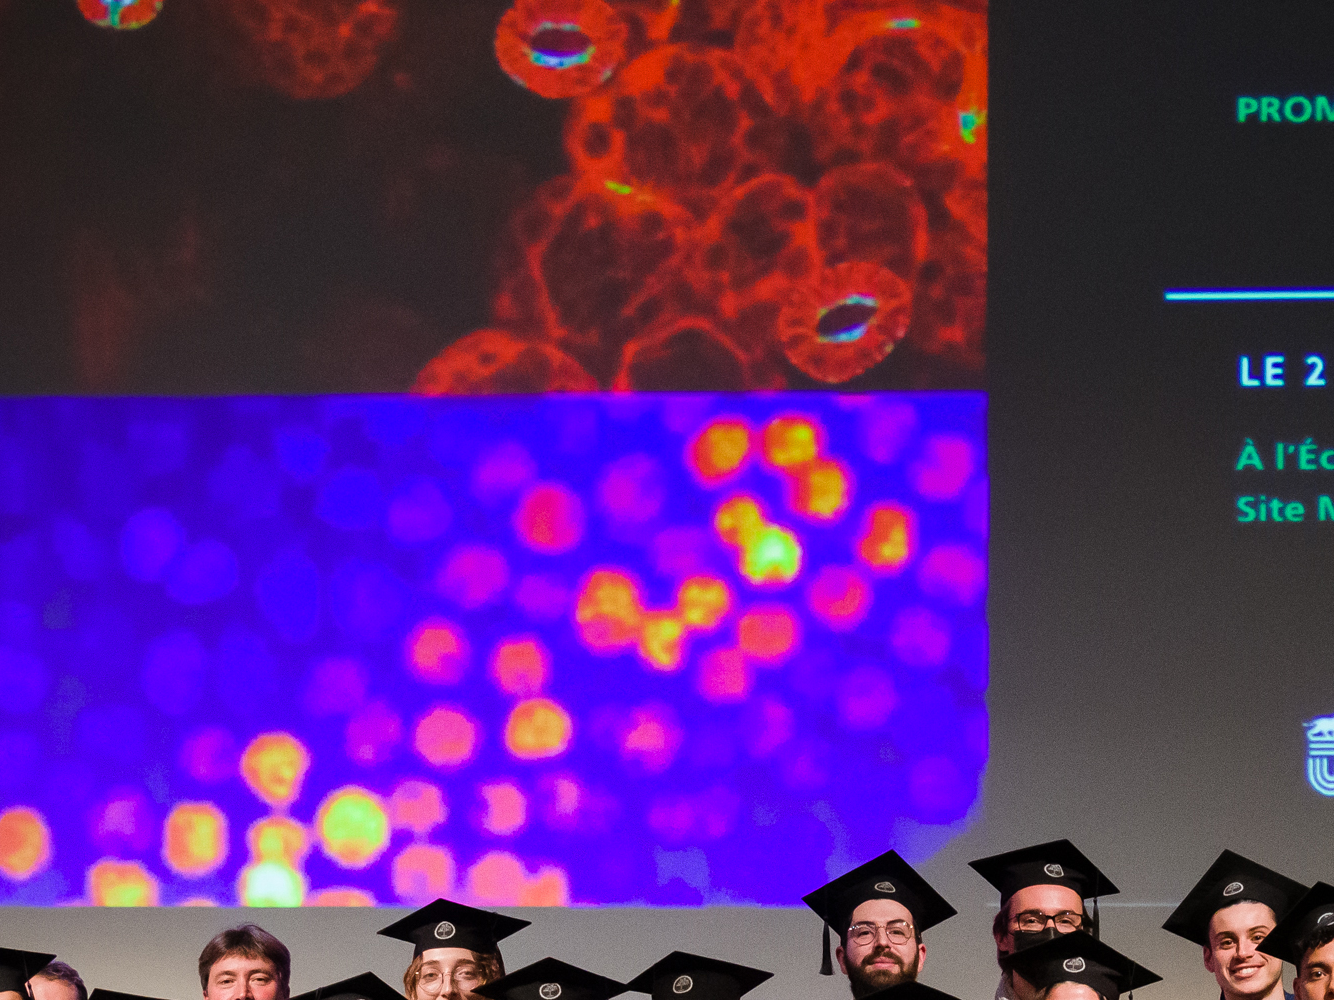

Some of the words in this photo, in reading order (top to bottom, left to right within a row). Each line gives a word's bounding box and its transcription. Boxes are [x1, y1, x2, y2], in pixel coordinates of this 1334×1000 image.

[1239, 355, 1285, 387] LE
[1304, 355, 1327, 387] 2
[1235, 437, 1265, 471] À
[1236, 494, 1306, 523] Site
